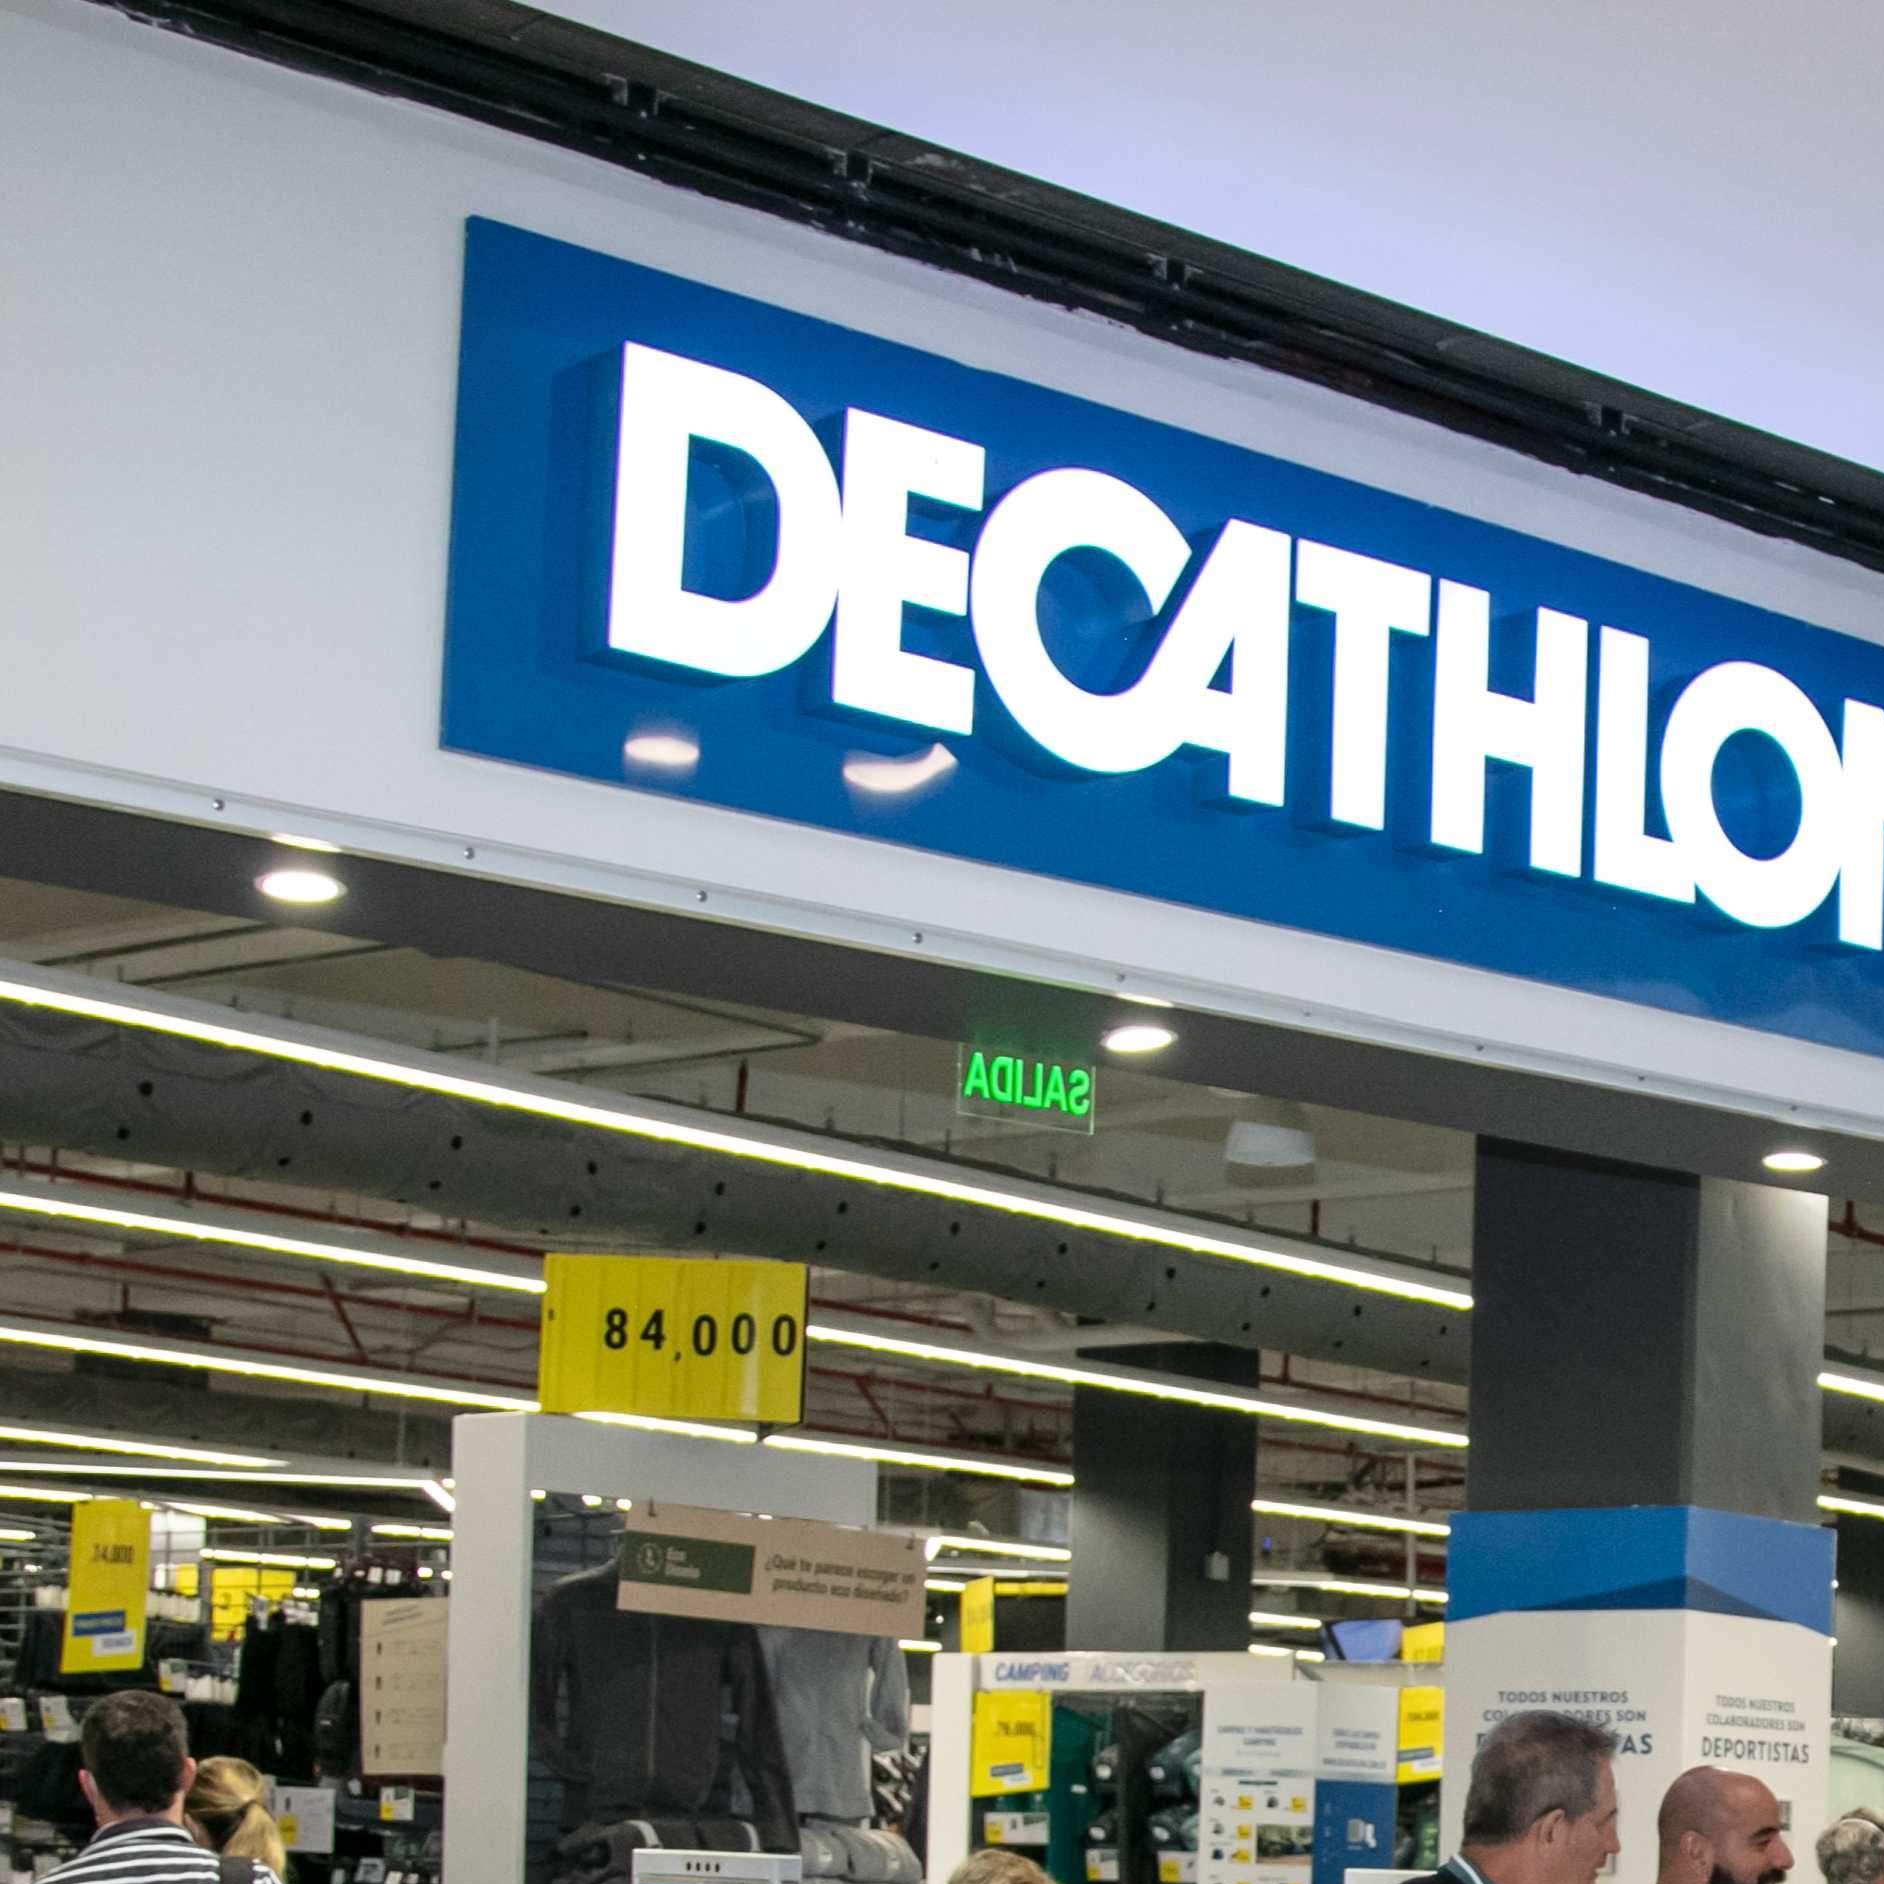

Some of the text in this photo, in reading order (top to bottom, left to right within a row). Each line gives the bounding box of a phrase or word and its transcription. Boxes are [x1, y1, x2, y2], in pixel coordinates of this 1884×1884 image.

[604, 1307, 798, 1362] 84,000
[995, 1663, 1070, 1682] CAMPING
[1498, 1690, 1629, 1704] TODOS NUESTROS
[1715, 1694, 1796, 1713] TODOS NUESTROS
[1615, 1709, 1648, 1722] SON
[1705, 1713, 1785, 1731] COLABORADORES
[1701, 1735, 1810, 1764] DEPORTISTAS
